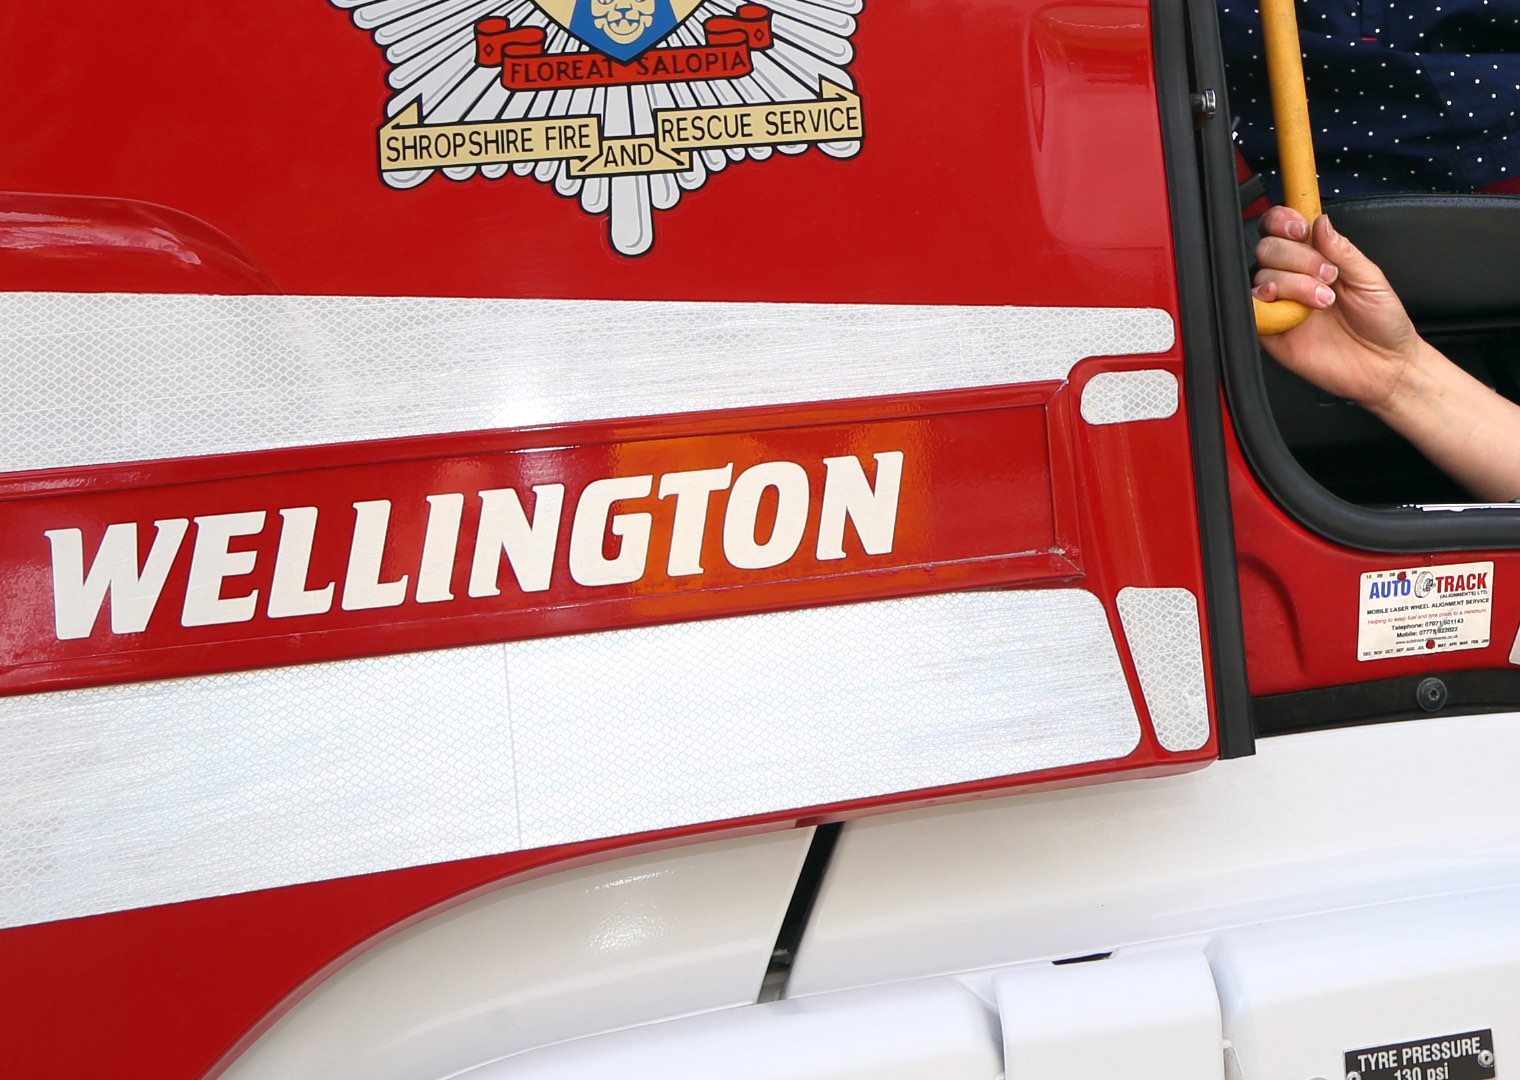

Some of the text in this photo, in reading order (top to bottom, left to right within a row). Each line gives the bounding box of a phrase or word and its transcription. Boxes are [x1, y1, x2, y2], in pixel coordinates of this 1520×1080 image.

[510, 51, 747, 83] FLOREAT SALOPIA
[661, 105, 859, 144] RESCUE SERVICE
[385, 124, 592, 163] SHROPSHIRE FIRE
[603, 141, 655, 169] AND
[43, 451, 906, 640] WELLINGTON
[1368, 573, 1489, 599] AUTO TRACK
[1392, 623, 1424, 631] Telephone:
[1358, 1037, 1481, 1072] TYRE PRESSURE
